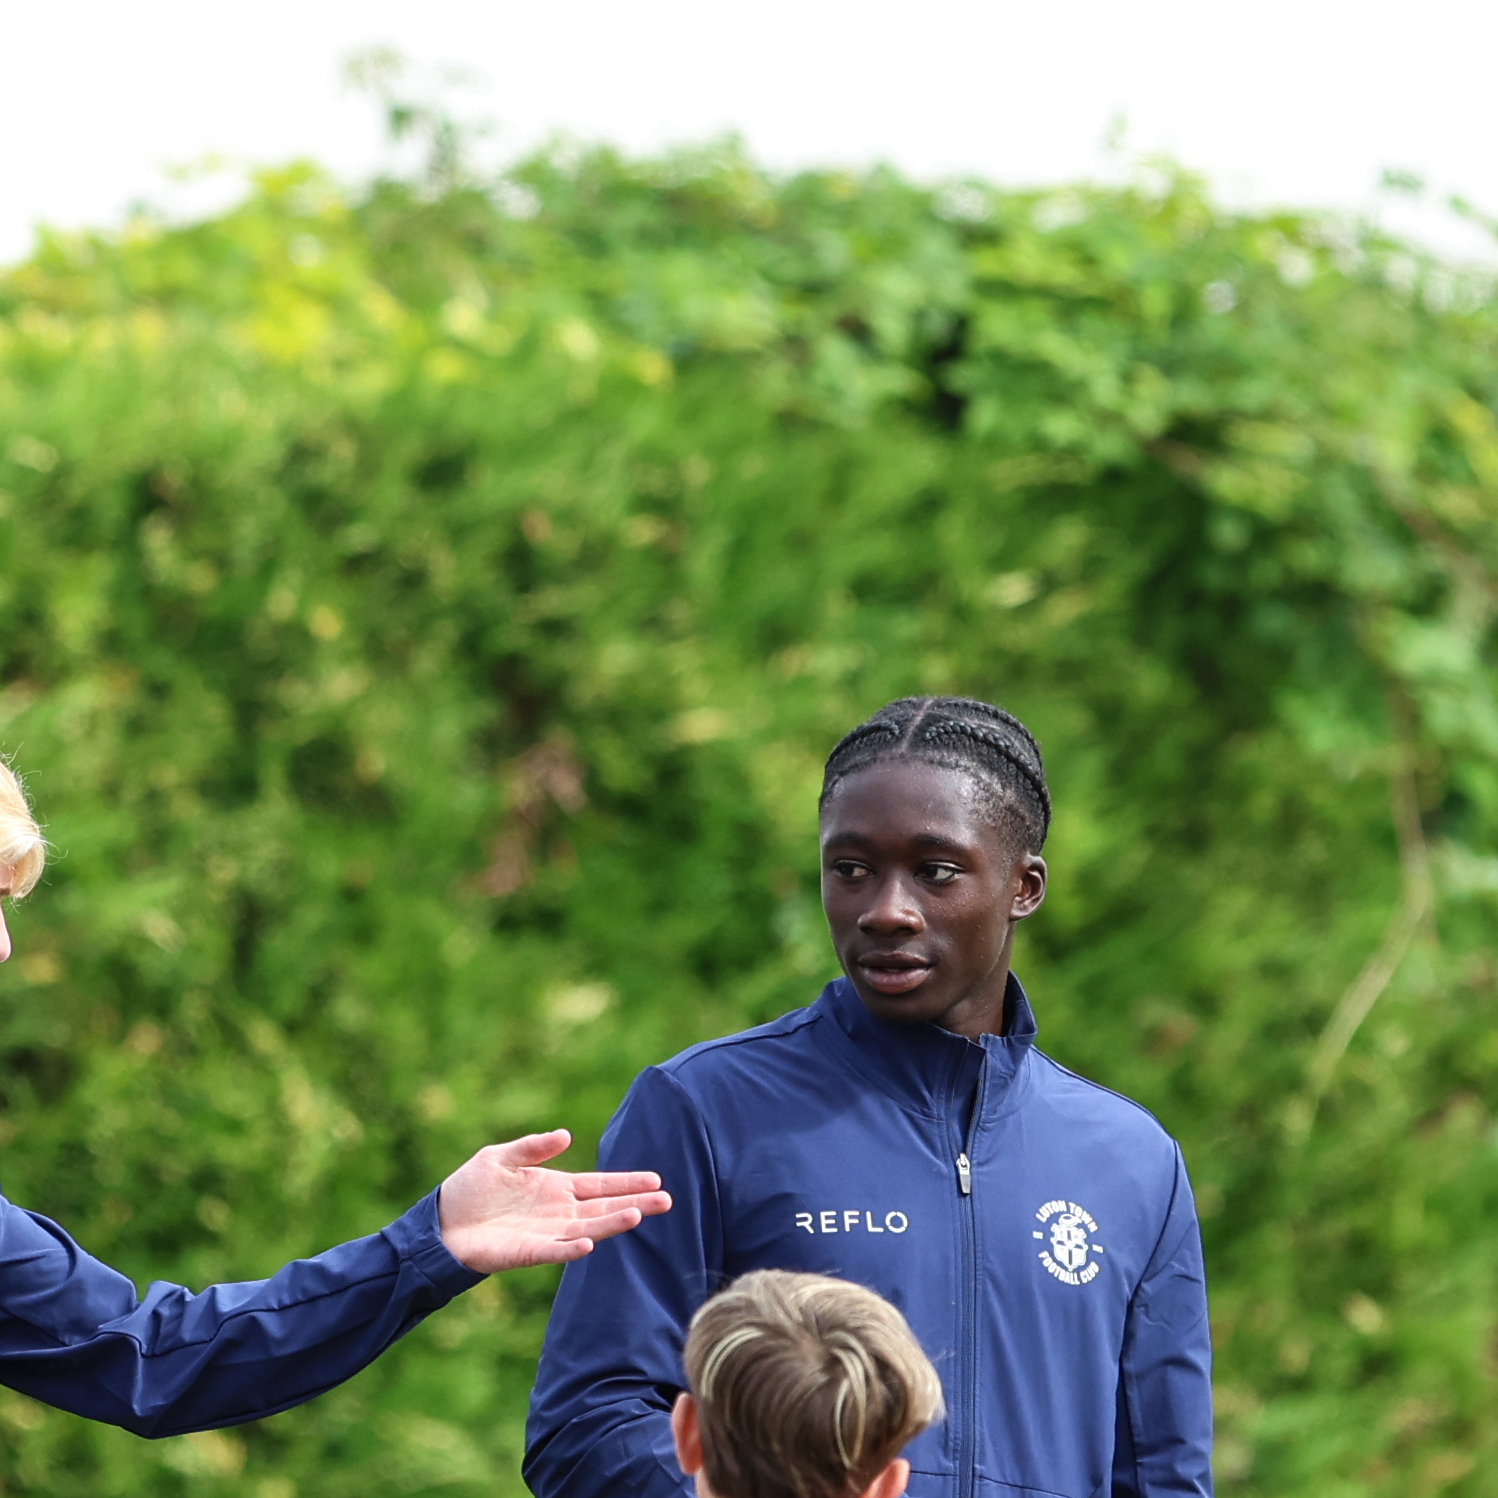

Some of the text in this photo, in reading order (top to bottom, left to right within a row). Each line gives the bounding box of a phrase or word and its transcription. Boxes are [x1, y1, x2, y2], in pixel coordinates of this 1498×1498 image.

[795, 1210, 908, 1234] REFLO
[1035, 1200, 1099, 1233] LUTON TOWN
[1038, 1250, 1099, 1285] FOOTBALL CLUB
